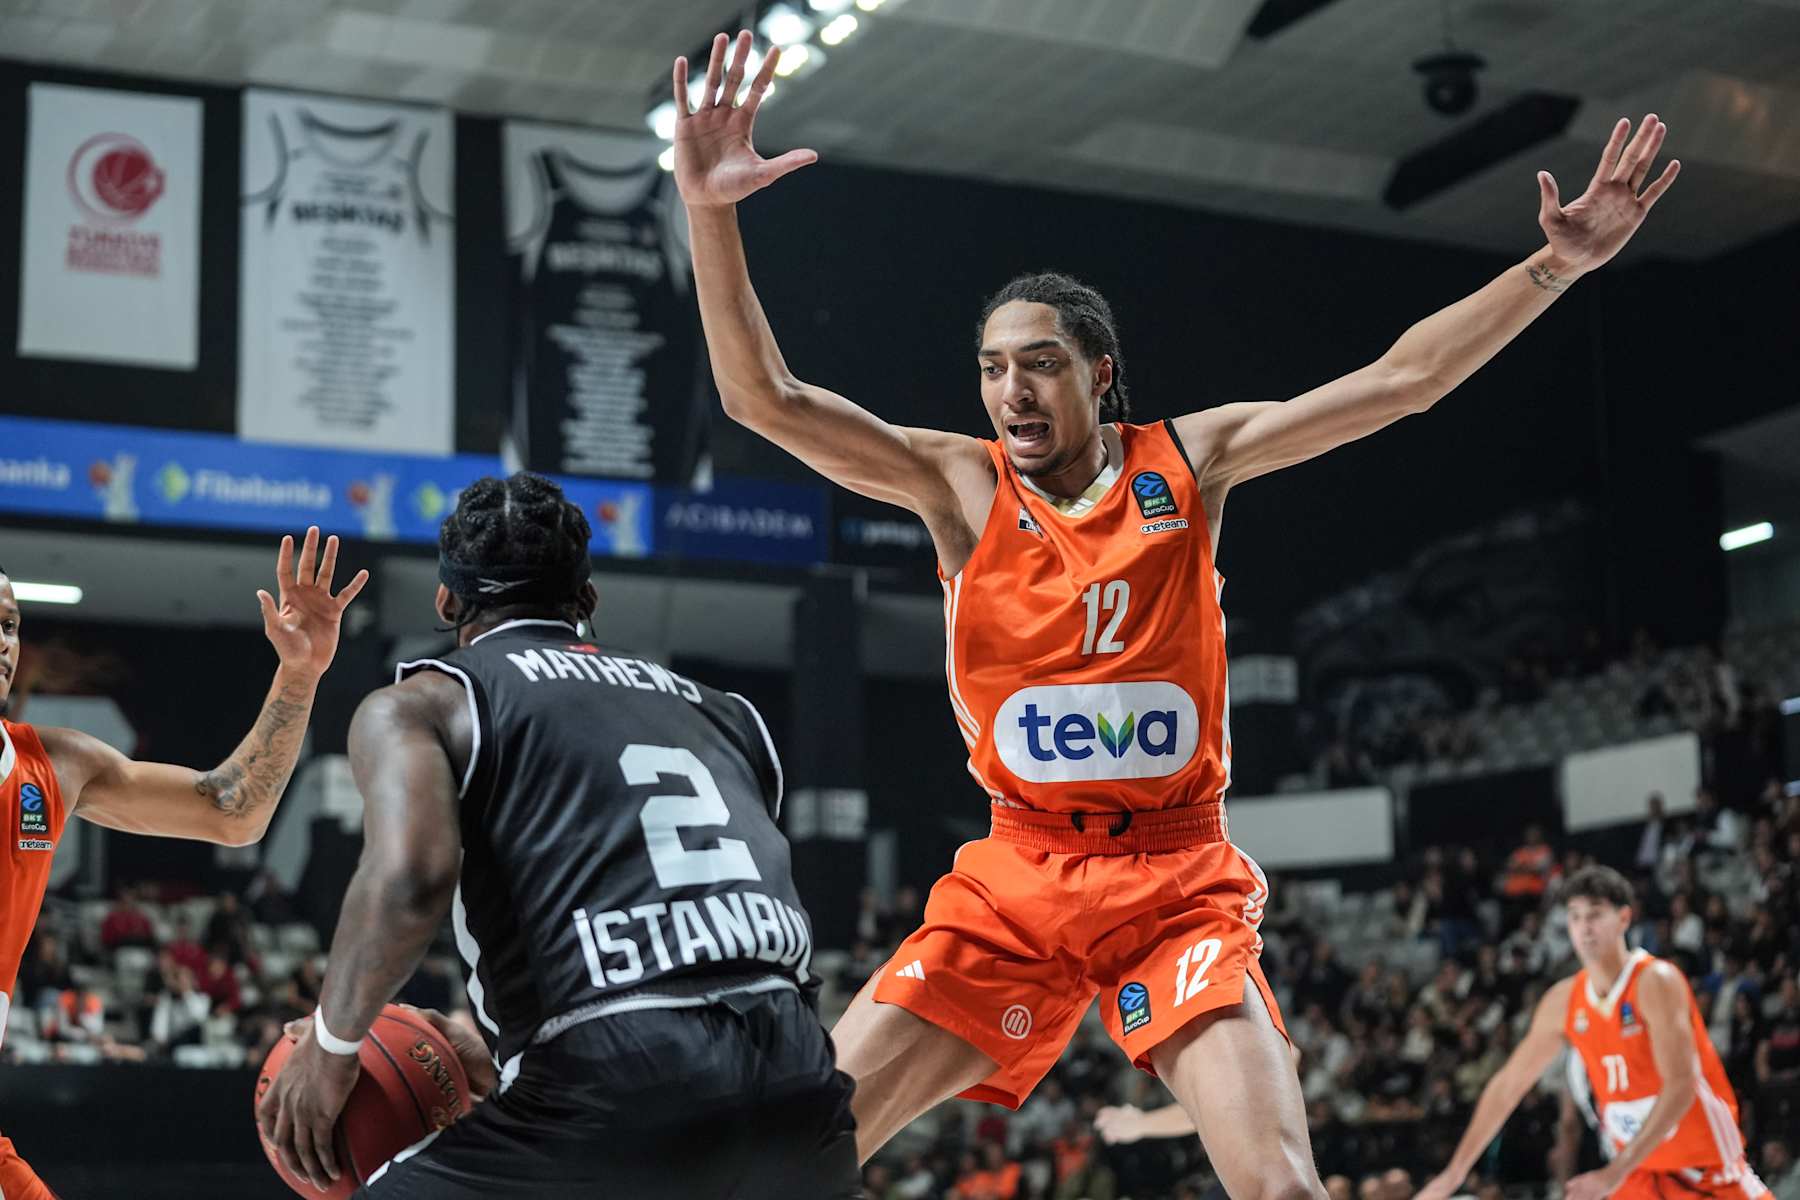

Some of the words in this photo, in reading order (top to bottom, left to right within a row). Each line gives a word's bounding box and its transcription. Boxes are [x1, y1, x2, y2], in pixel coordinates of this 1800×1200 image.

[1143, 505, 1174, 516] EuroCup
[1081, 579, 1131, 656] 12
[505, 648, 703, 704] MATHEWS
[1017, 703, 1178, 763] teva
[618, 743, 762, 889] 2
[1173, 938, 1223, 1008] 12
[1125, 1016, 1150, 1033] EuroCup
